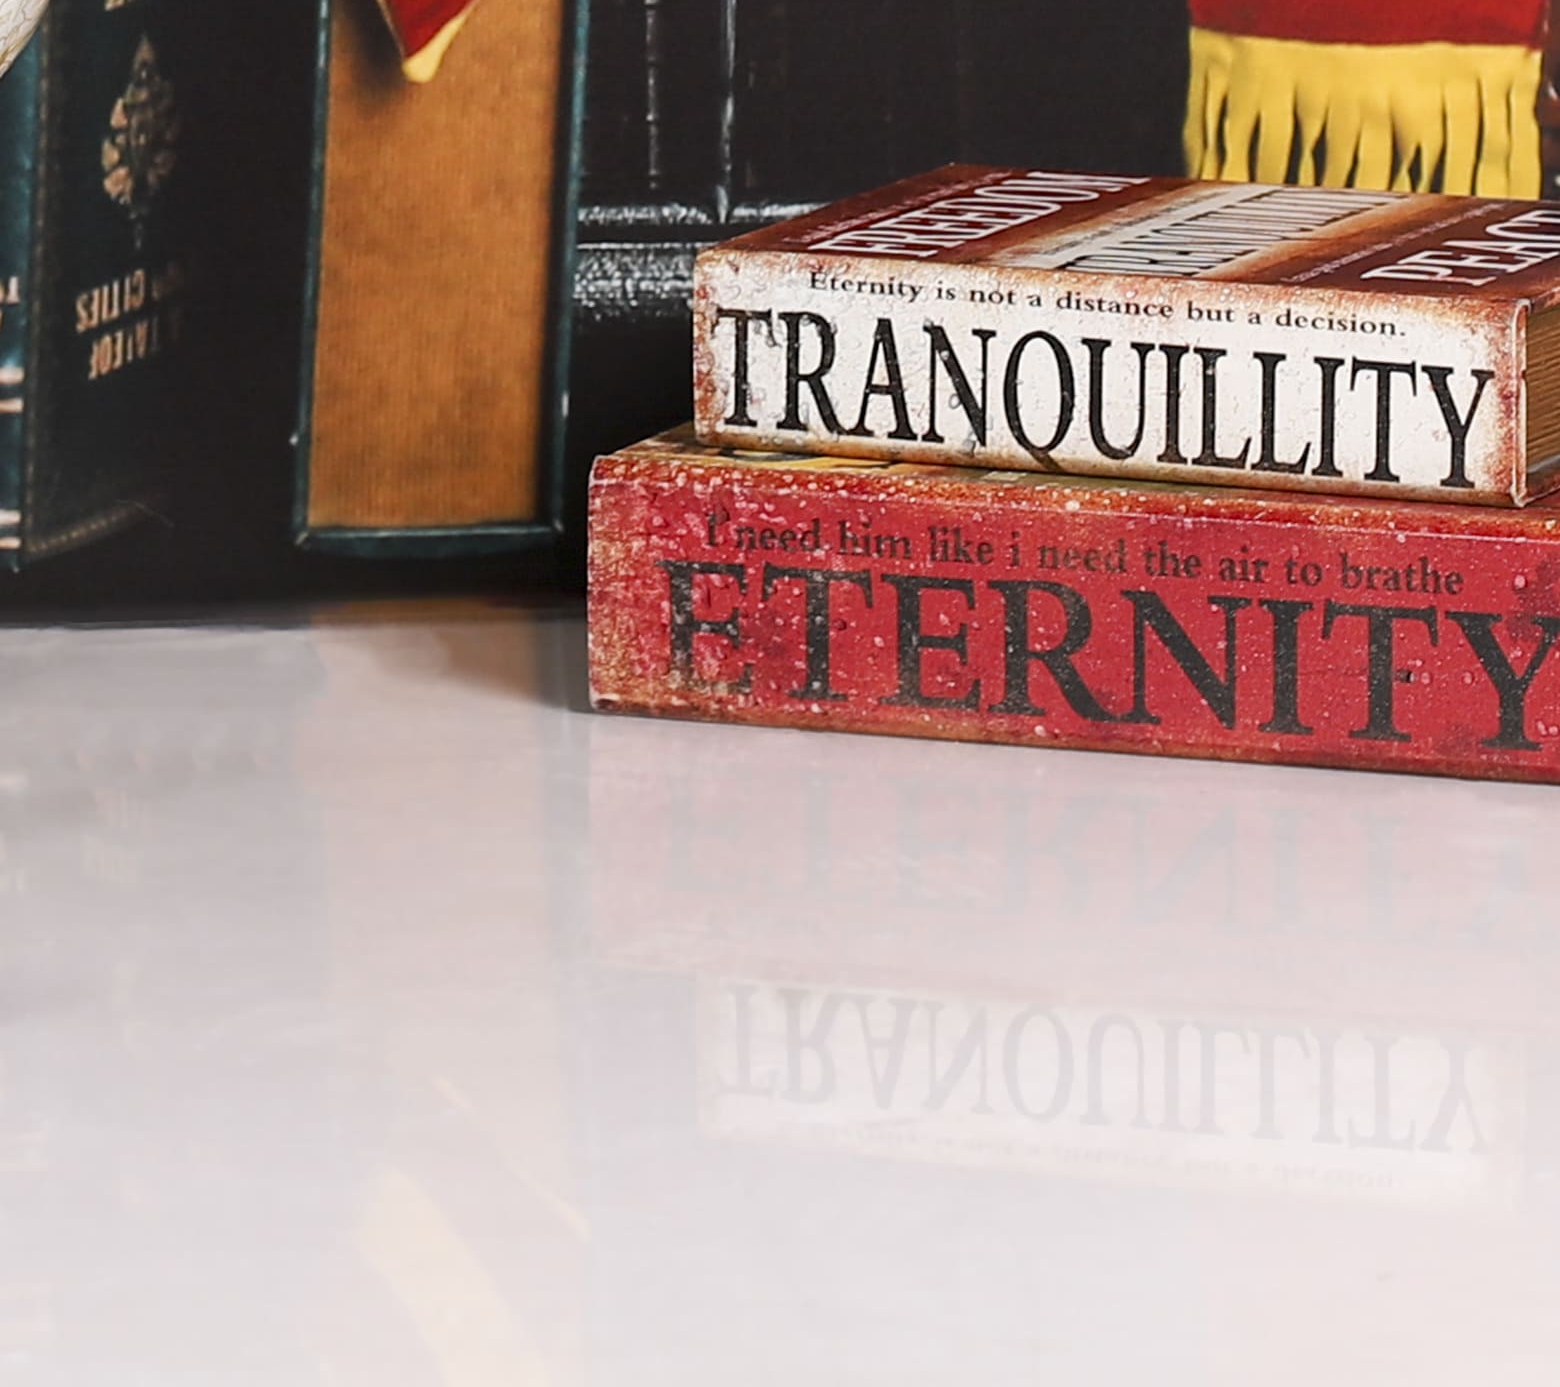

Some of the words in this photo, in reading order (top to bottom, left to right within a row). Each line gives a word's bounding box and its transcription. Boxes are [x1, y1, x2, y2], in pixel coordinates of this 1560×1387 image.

[808, 170, 1152, 259] FREEDOM
[809, 269, 925, 304] Eternity
[936, 280, 957, 301] is
[968, 287, 1015, 306] not
[1028, 293, 1043, 308] a
[1055, 289, 1174, 319] distance
[1187, 300, 1236, 325] but
[1247, 309, 1263, 326] a
[1274, 307, 1407, 338] decision.
[710, 305, 1496, 492] TRANQUILLITY
[734, 518, 822, 555] need
[837, 519, 913, 561] him
[927, 524, 996, 566] like
[1036, 536, 1129, 575] need
[1143, 540, 1203, 580] the
[1217, 545, 1270, 584] air
[1283, 554, 1325, 588] to
[1338, 551, 1466, 598] brathe
